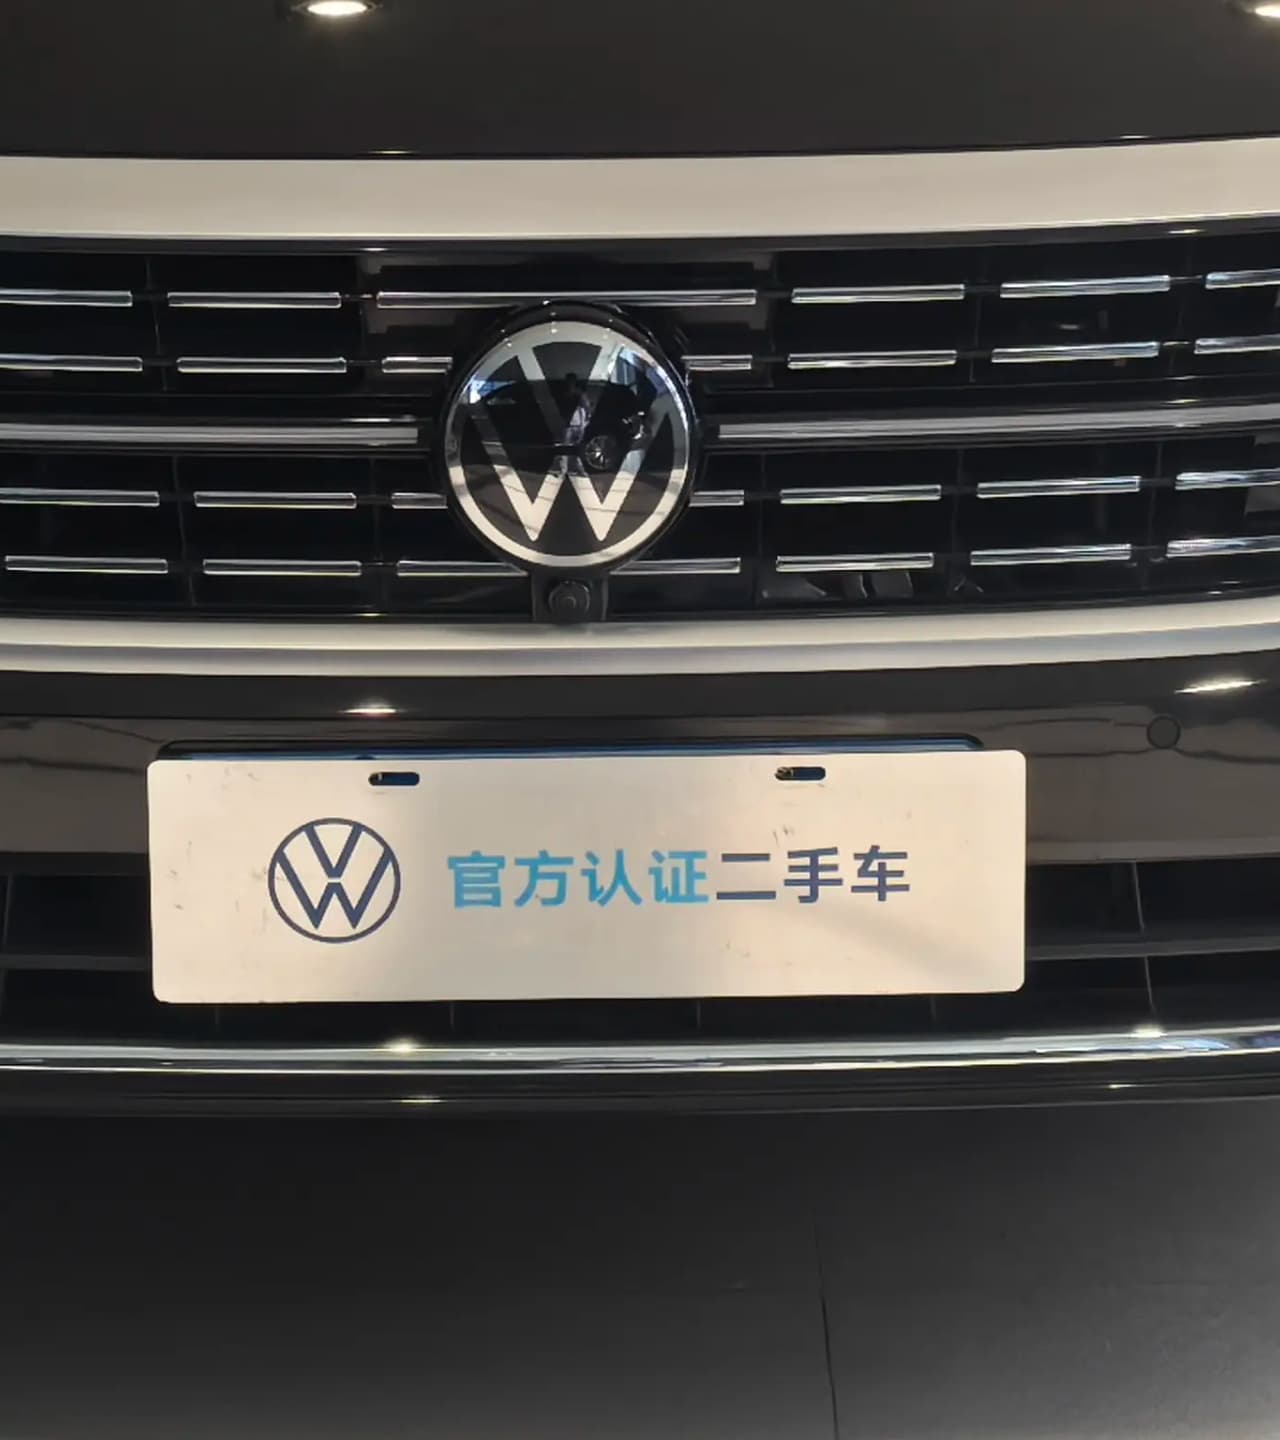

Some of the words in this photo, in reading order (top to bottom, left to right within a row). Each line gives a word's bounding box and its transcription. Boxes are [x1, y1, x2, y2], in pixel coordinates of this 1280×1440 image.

[446, 844, 912, 910] 官方认证二手车
